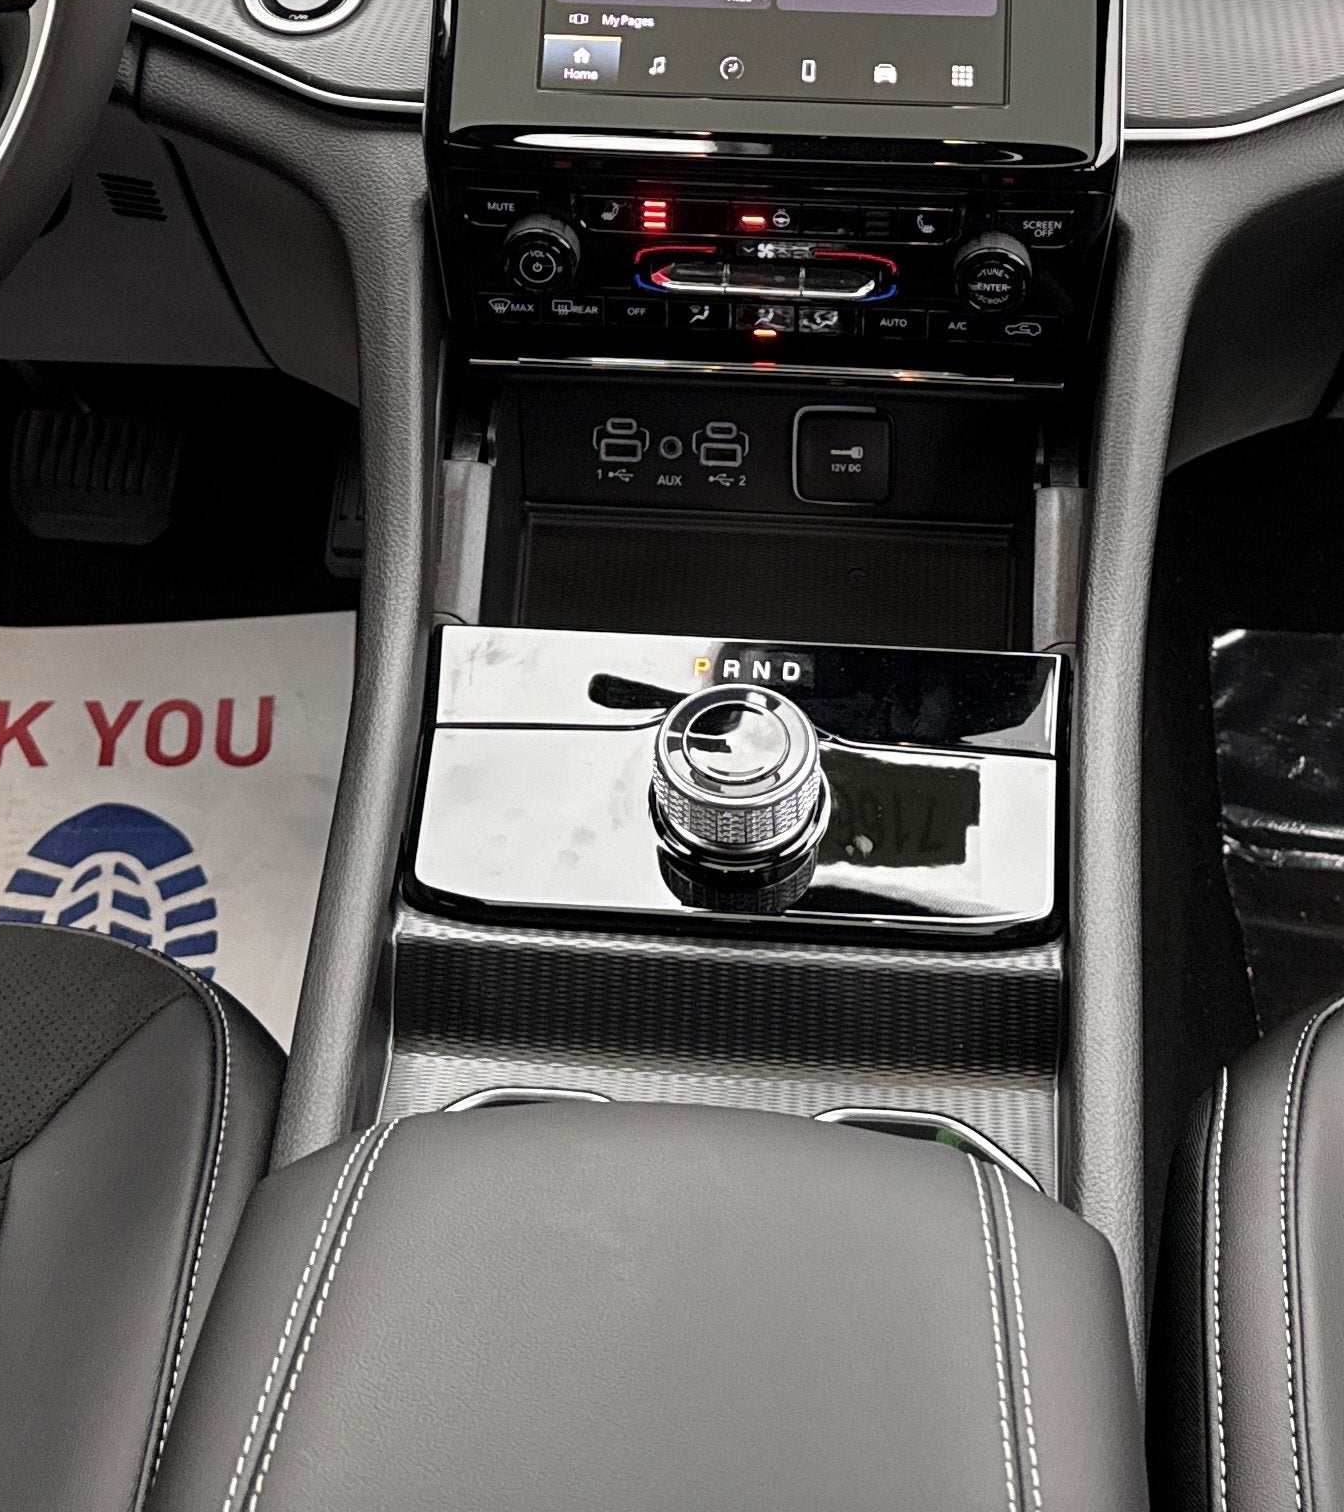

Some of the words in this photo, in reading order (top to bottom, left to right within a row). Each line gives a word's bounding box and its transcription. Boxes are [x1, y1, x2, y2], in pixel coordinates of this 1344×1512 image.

[563, 68, 599, 81] Home
[487, 201, 516, 212] MUTE
[1022, 220, 1063, 230] SCREEN
[1034, 229, 1054, 238] OFF
[529, 249, 545, 258] VOL
[981, 268, 1004, 278] TUNE
[977, 283, 1008, 292] ENTER
[510, 303, 535, 313] MAX
[573, 304, 599, 315] REAR
[627, 306, 647, 316] OFF
[879, 318, 908, 328] AUTO
[948, 321, 968, 331] A/C
[830, 463, 847, 473] 12V
[848, 464, 862, 473] DC
[657, 474, 683, 486] AUX
[738, 475, 746, 487] 2
[692, 657, 712, 677] P
[722, 659, 742, 679] R
[752, 660, 772, 681] N
[782, 661, 802, 682] D
[84, 695, 277, 769] YOU
